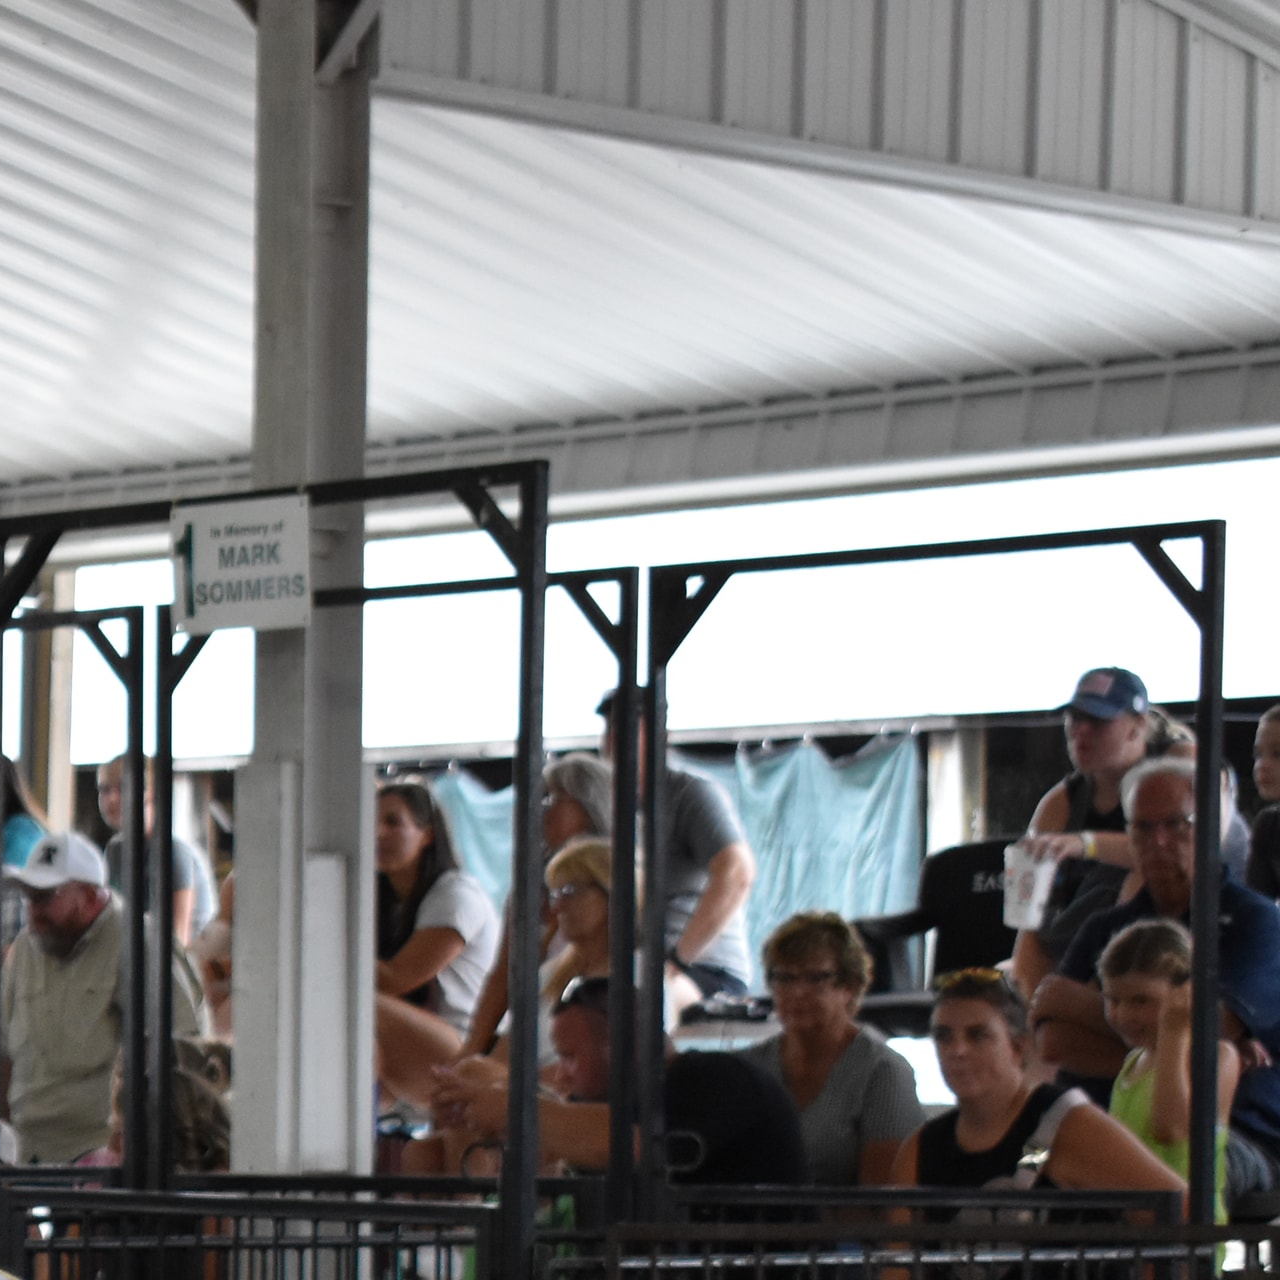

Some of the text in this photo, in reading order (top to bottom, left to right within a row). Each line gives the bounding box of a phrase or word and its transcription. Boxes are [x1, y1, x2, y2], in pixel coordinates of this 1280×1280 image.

[224, 523, 269, 538] Memory
[272, 520, 284, 532] of
[175, 522, 195, 617] 1
[218, 542, 280, 570] MARK
[195, 574, 306, 606] SOMMERS
